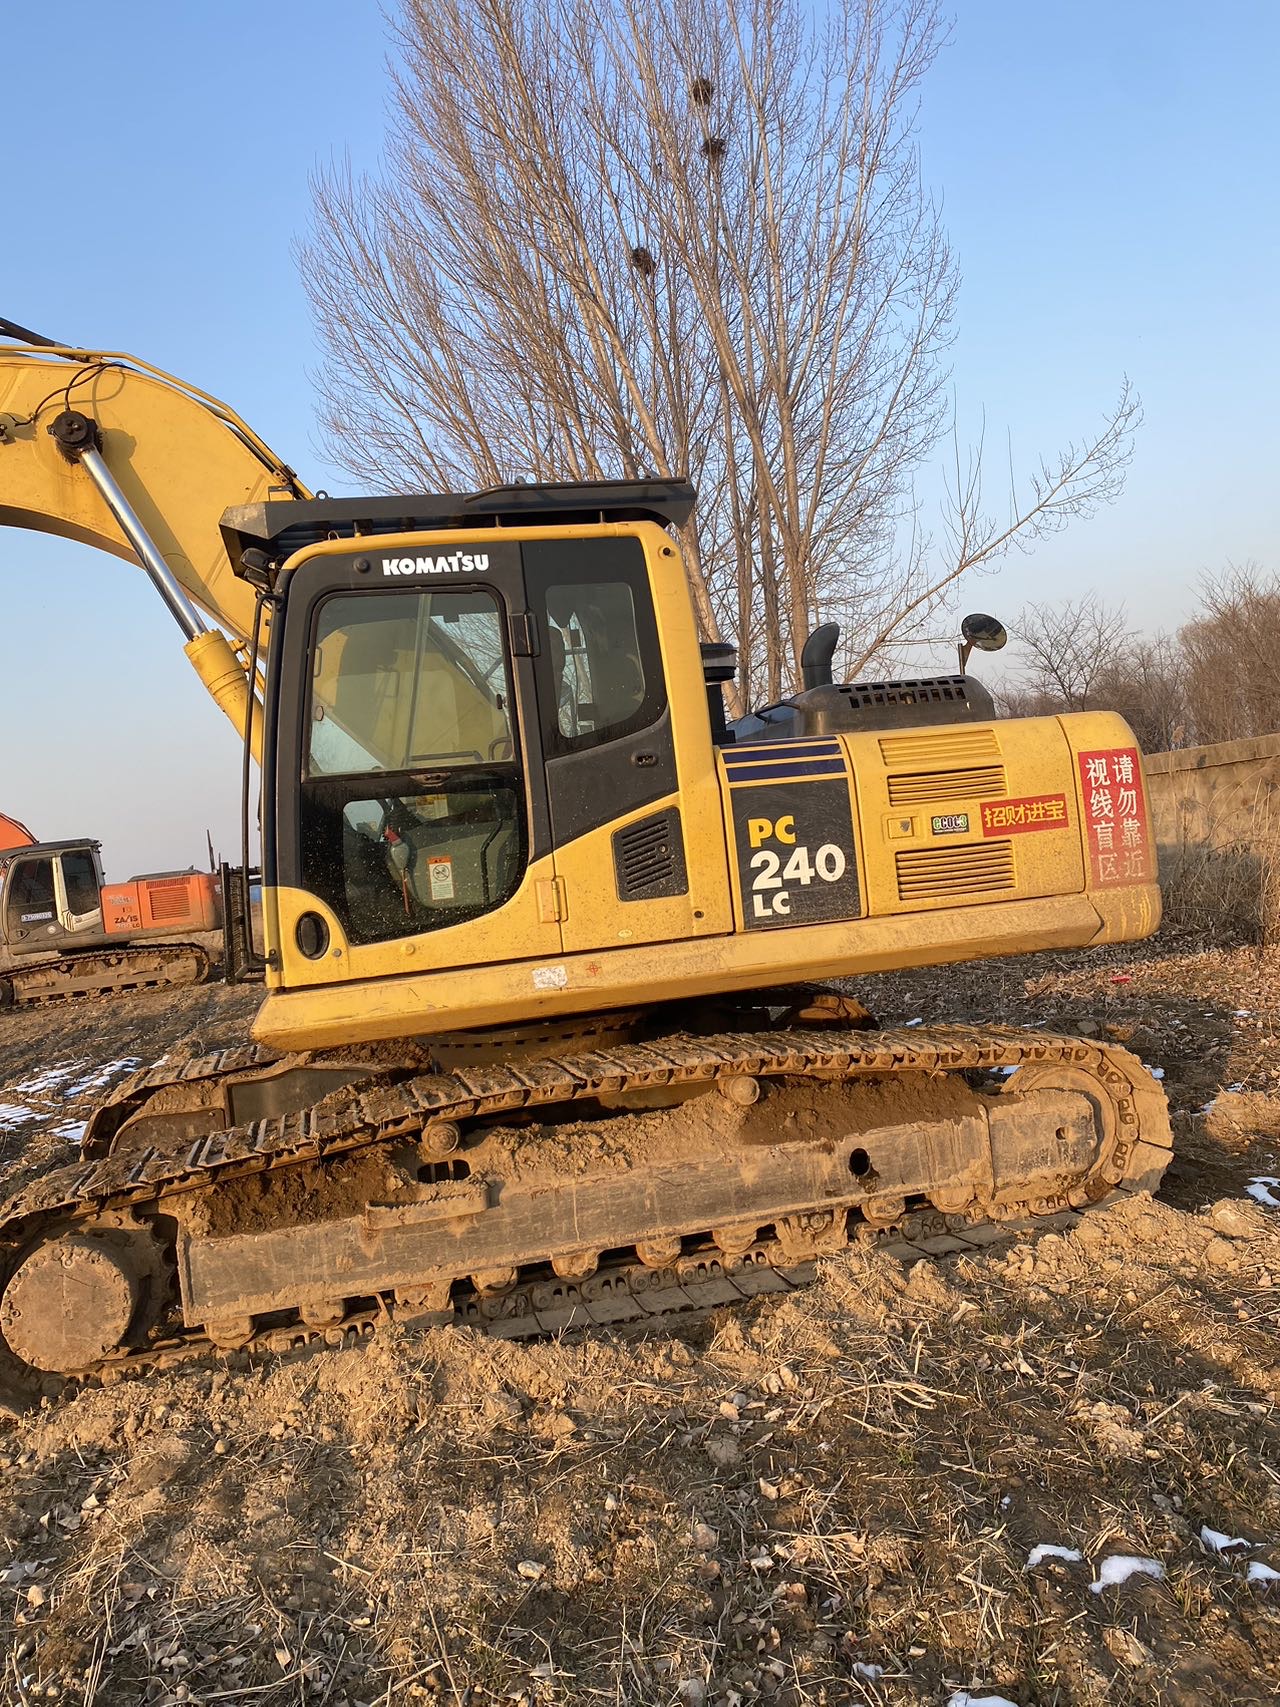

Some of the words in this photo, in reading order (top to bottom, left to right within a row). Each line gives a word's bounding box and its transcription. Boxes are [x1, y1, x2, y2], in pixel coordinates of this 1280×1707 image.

[382, 551, 489, 576] KOMATSU
[984, 800, 1066, 828] 招财进宝
[1086, 757, 1120, 882] 视线盲区
[1112, 754, 1145, 878] 请勿靠近
[748, 815, 796, 848] PC
[750, 844, 846, 890] 240
[753, 891, 790, 917] LC
